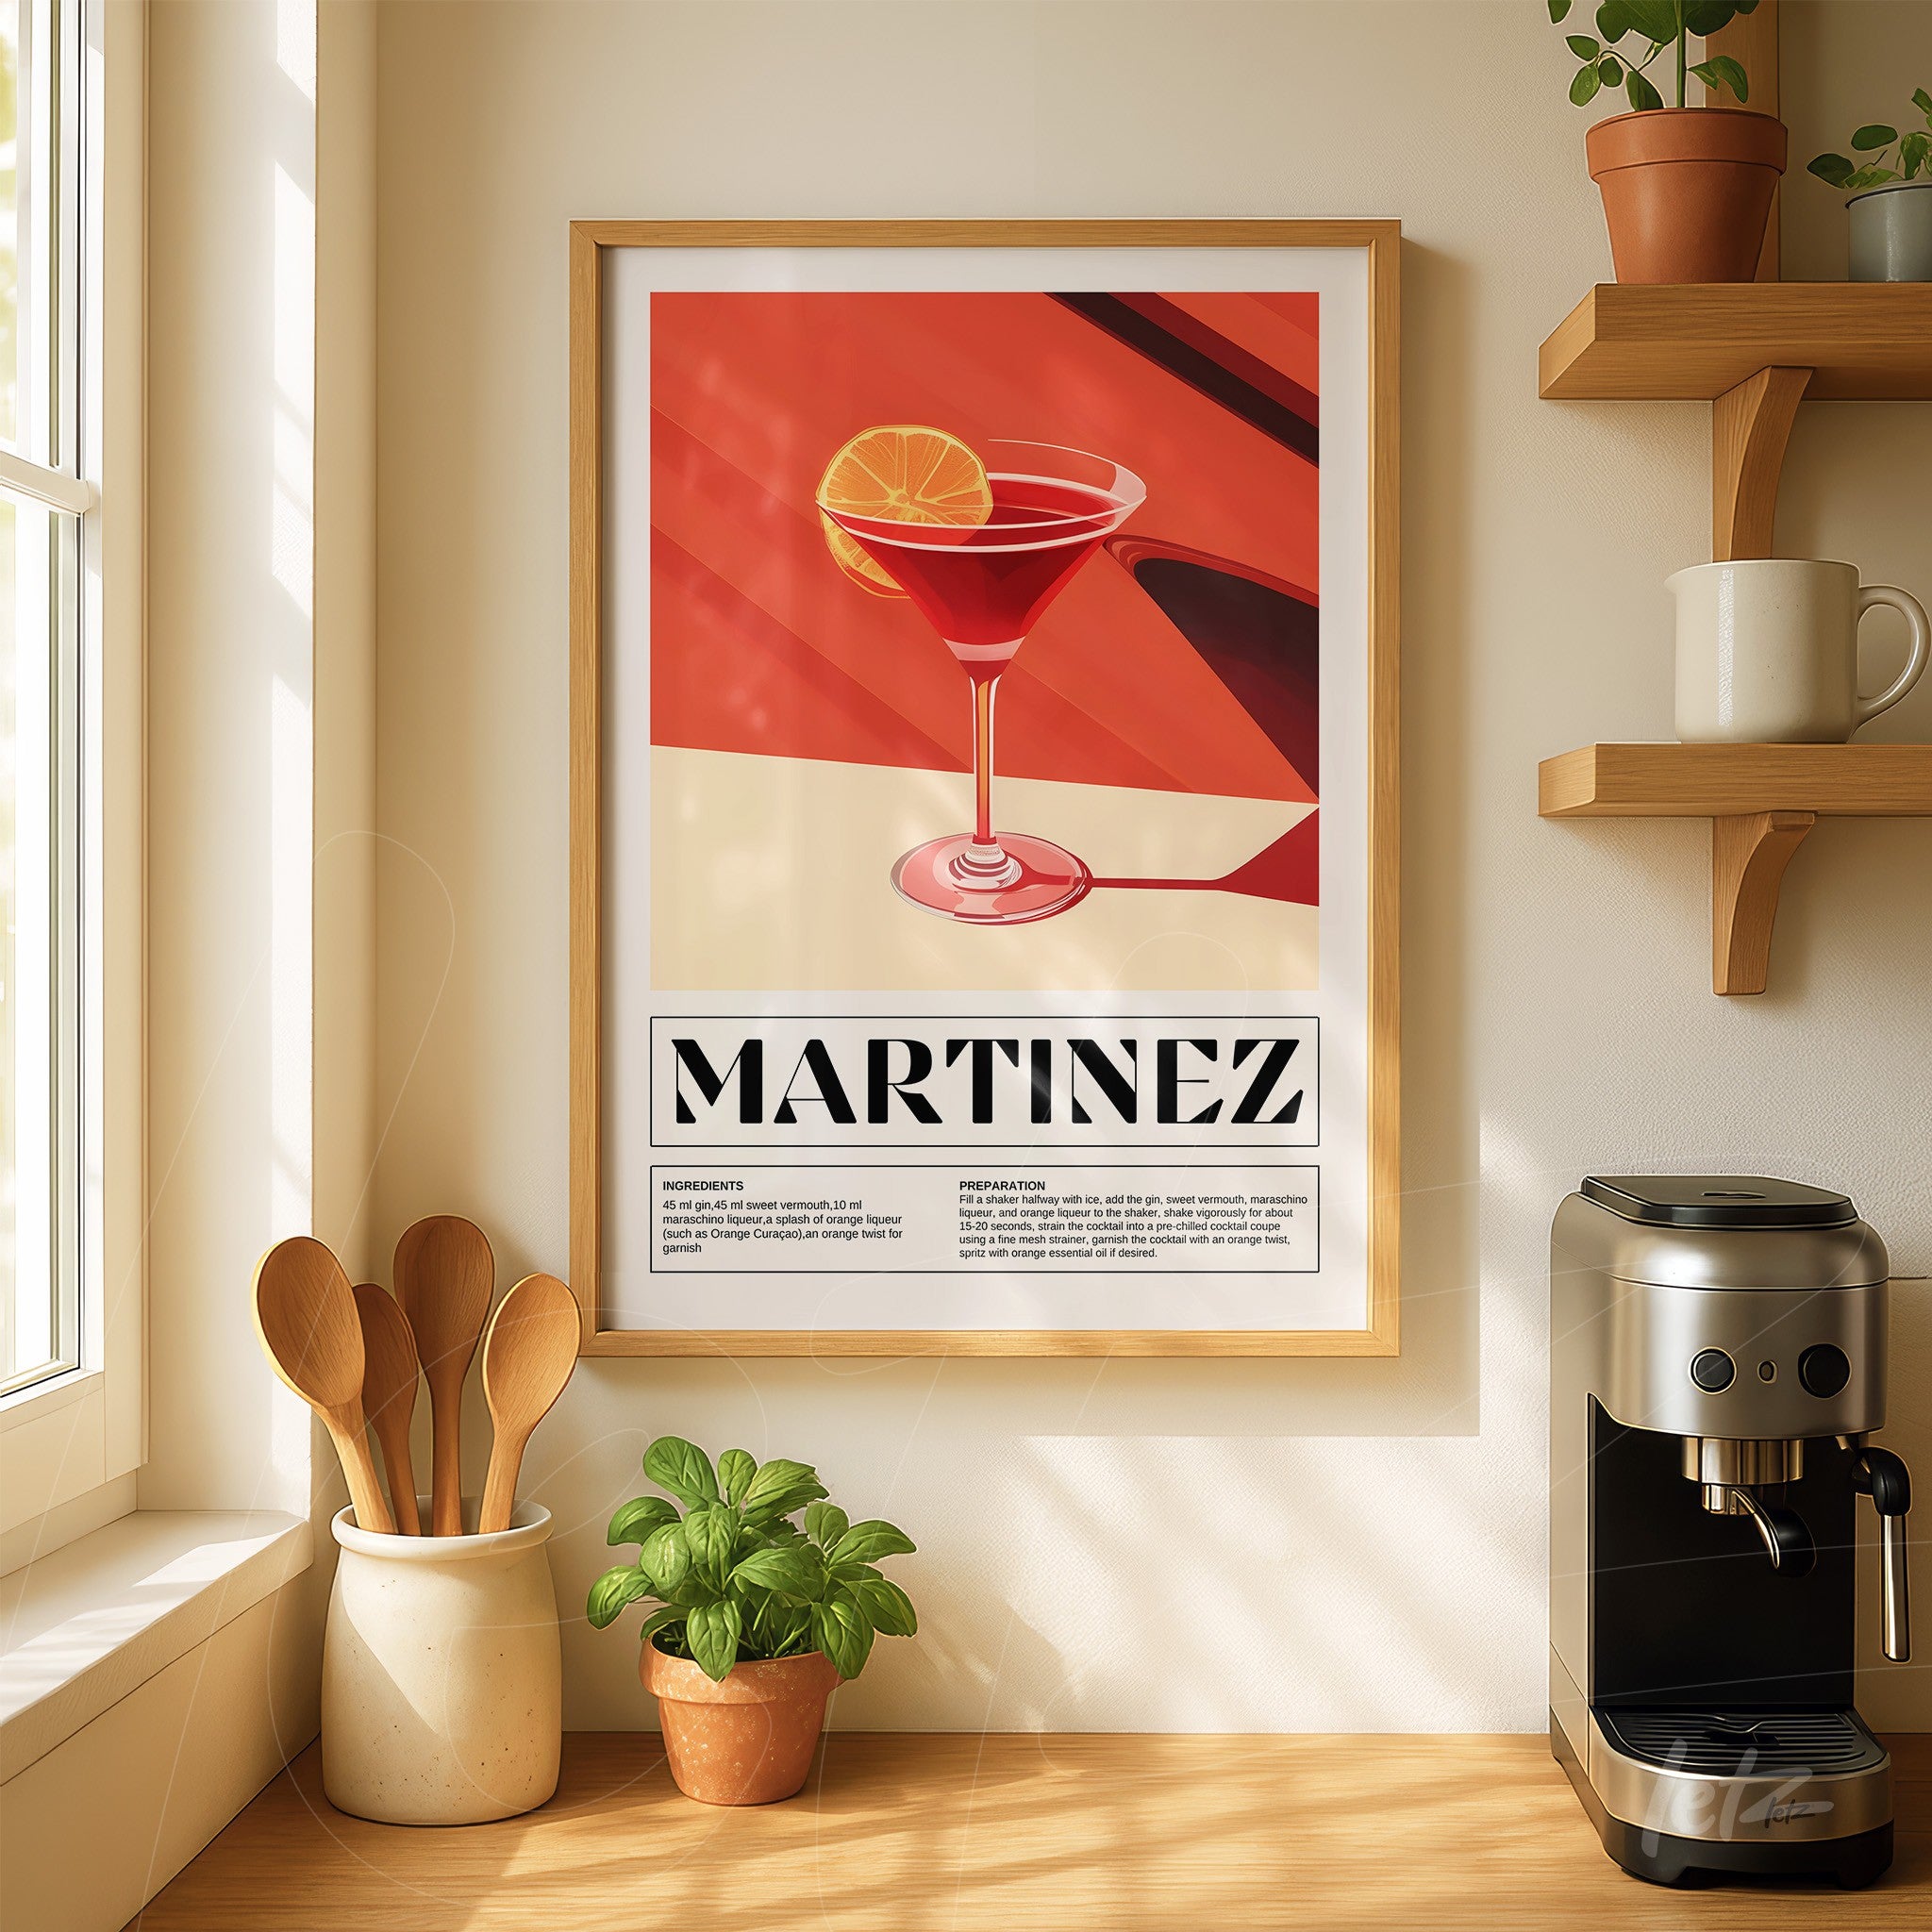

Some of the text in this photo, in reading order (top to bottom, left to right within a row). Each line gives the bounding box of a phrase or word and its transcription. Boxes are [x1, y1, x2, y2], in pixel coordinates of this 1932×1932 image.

[671, 1039, 1304, 1124] MARTINEZ
[662, 1180, 744, 1191] INGREDIENTS
[959, 1180, 1046, 1191] PREPARATION
[662, 1199, 862, 1213] 45 ml gin,45 ml sweet vermouth,10 ml
[959, 1193, 1308, 1207] Fill a shaker halfway with ice, add the gin, sweet vermouth, maraschino
[662, 1213, 903, 1227] maraschino liqueur,a splash of orange liqueur
[958, 1207, 1293, 1221] liqueur, and orange liqueur to the shaker, shake vigorously for about
[662, 1227, 904, 1241] (such as Orange Curaçao),an orange twist for
[959, 1220, 1281, 1234] 15-20 seconds, strain the cocktail into a pre-chilled cocktail coupe
[958, 1234, 1291, 1247] using a fine mesh strainer, garnish the cocktail with an orange twist,
[662, 1241, 702, 1256] garnish
[958, 1247, 1158, 1260] spritz with orange essential oil if desired.
